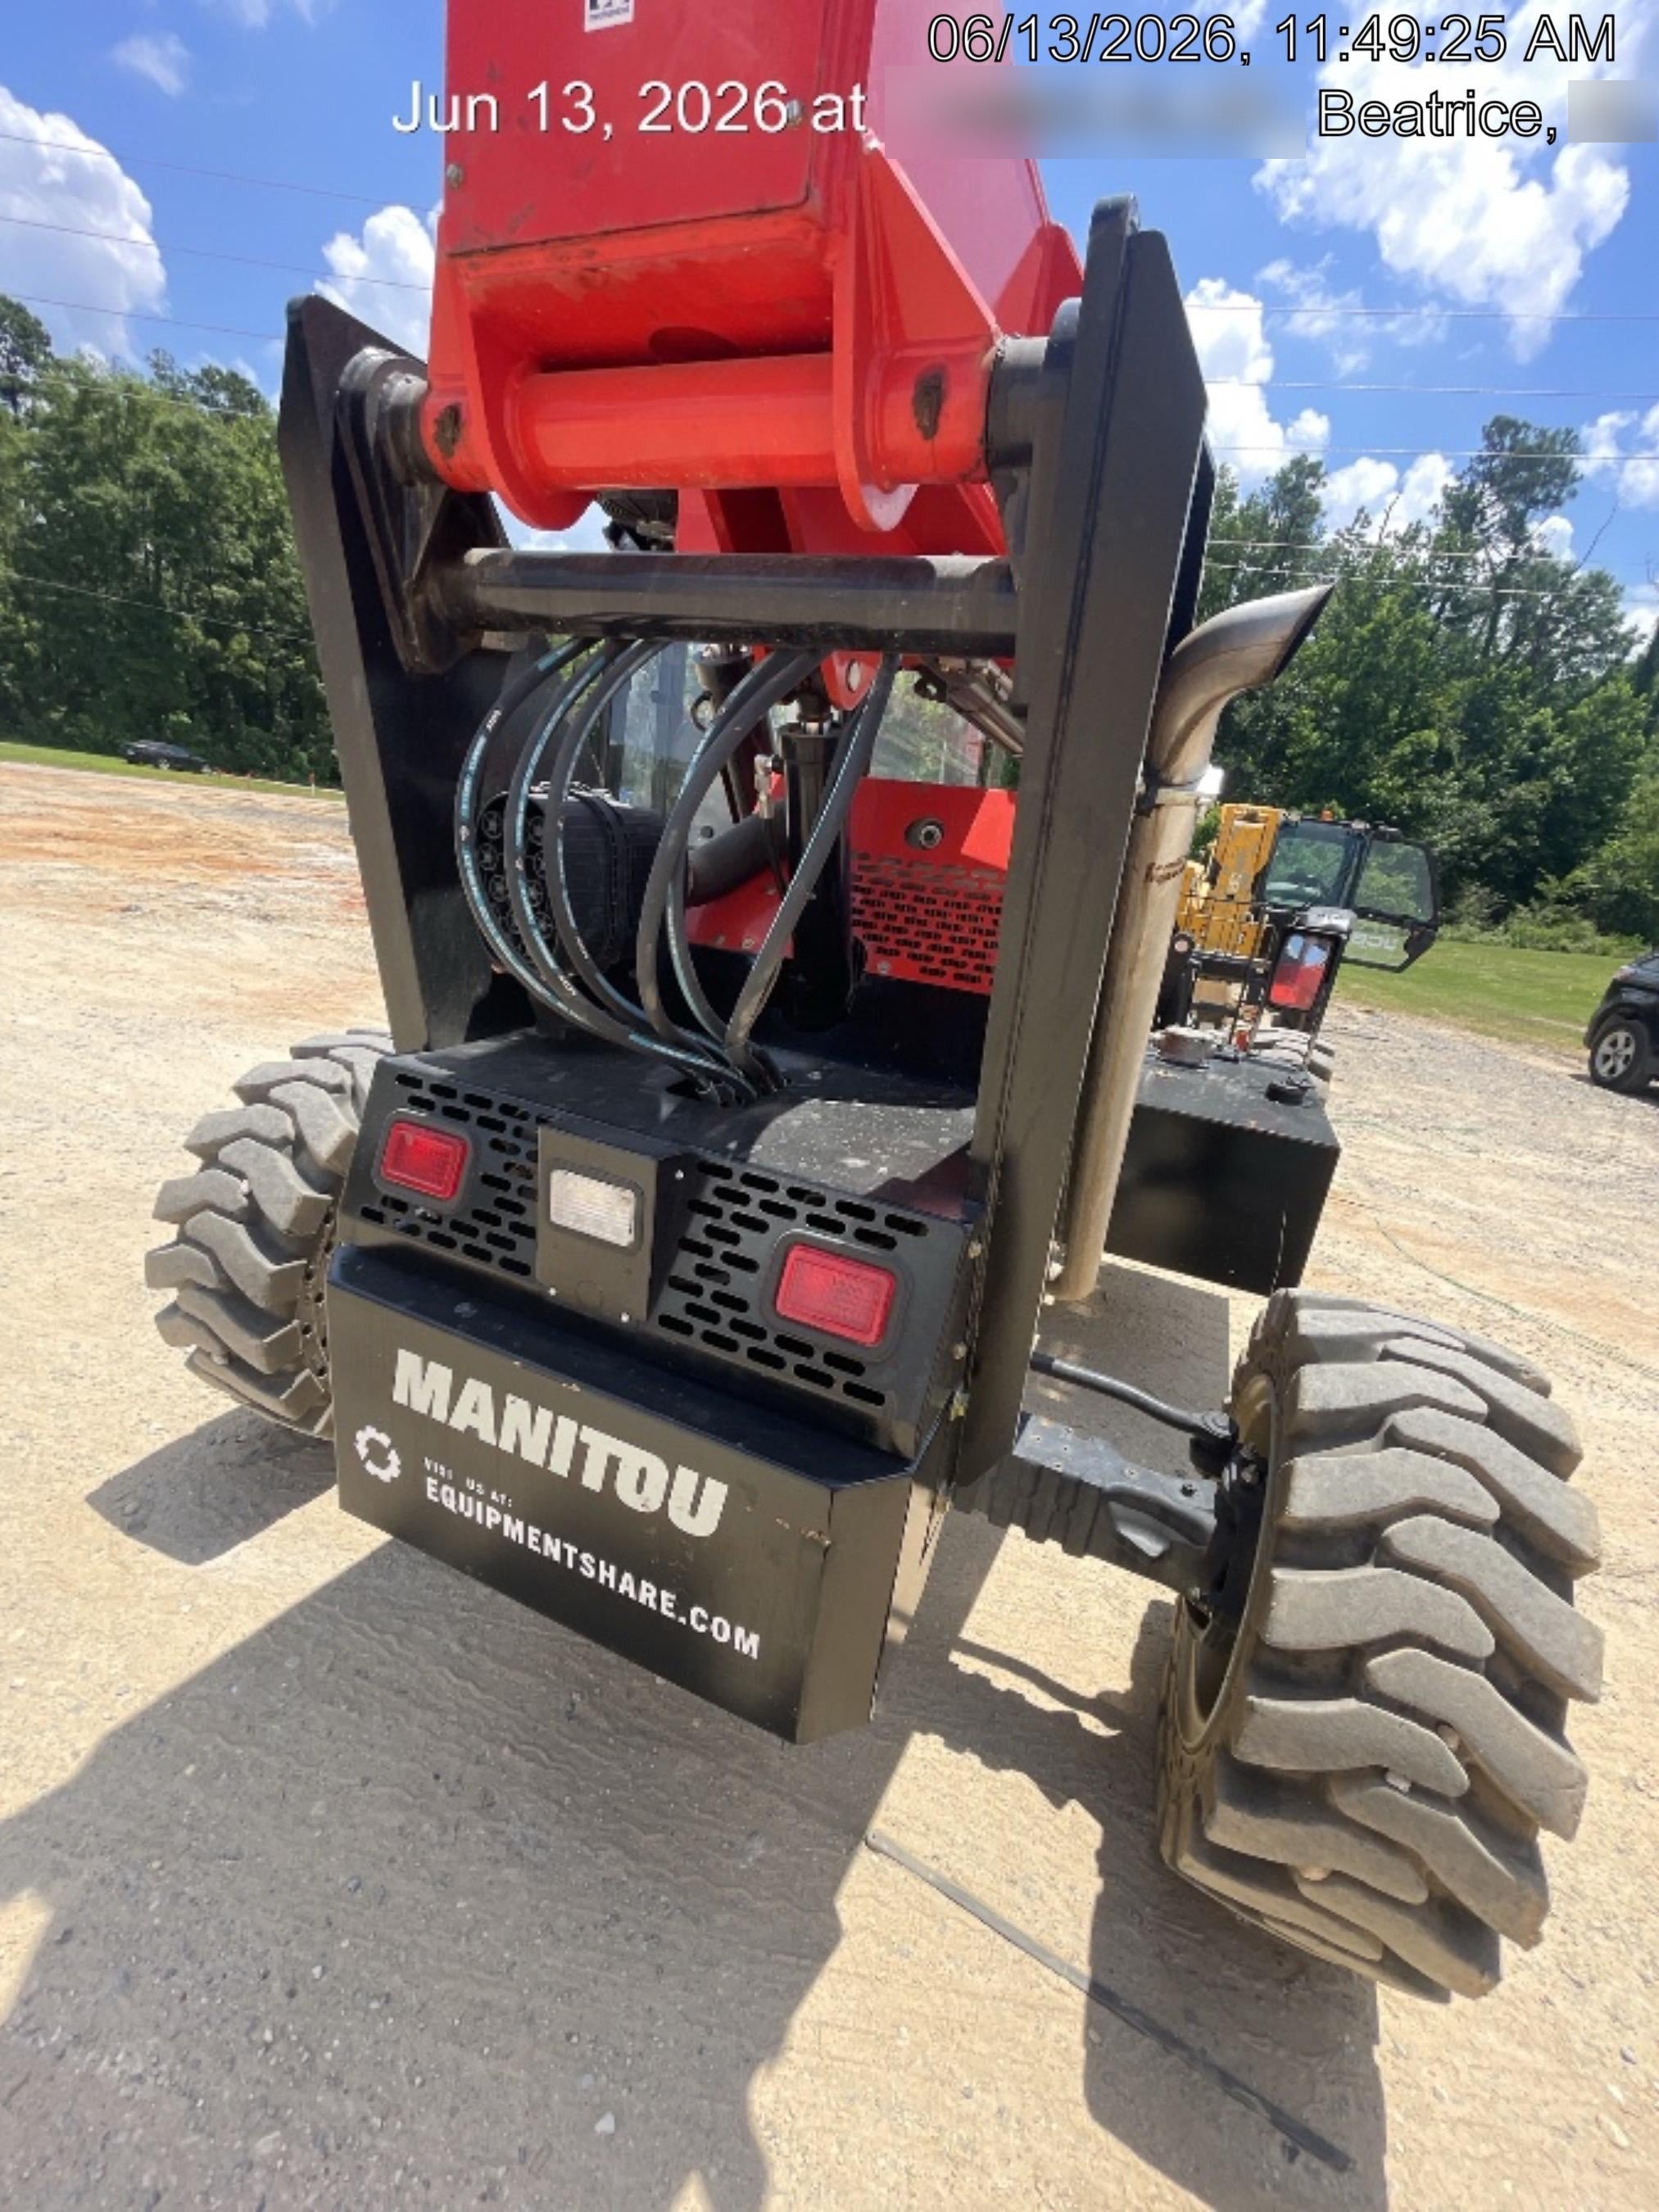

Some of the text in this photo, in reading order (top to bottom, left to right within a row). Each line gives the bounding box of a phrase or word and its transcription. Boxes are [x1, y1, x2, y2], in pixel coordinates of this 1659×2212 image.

[392, 1348, 728, 1538] MANITOU
[424, 1457, 456, 1481] VISI
[466, 1477, 485, 1495] US
[426, 1476, 760, 1660] EQUIPMENTSHARE.COM
